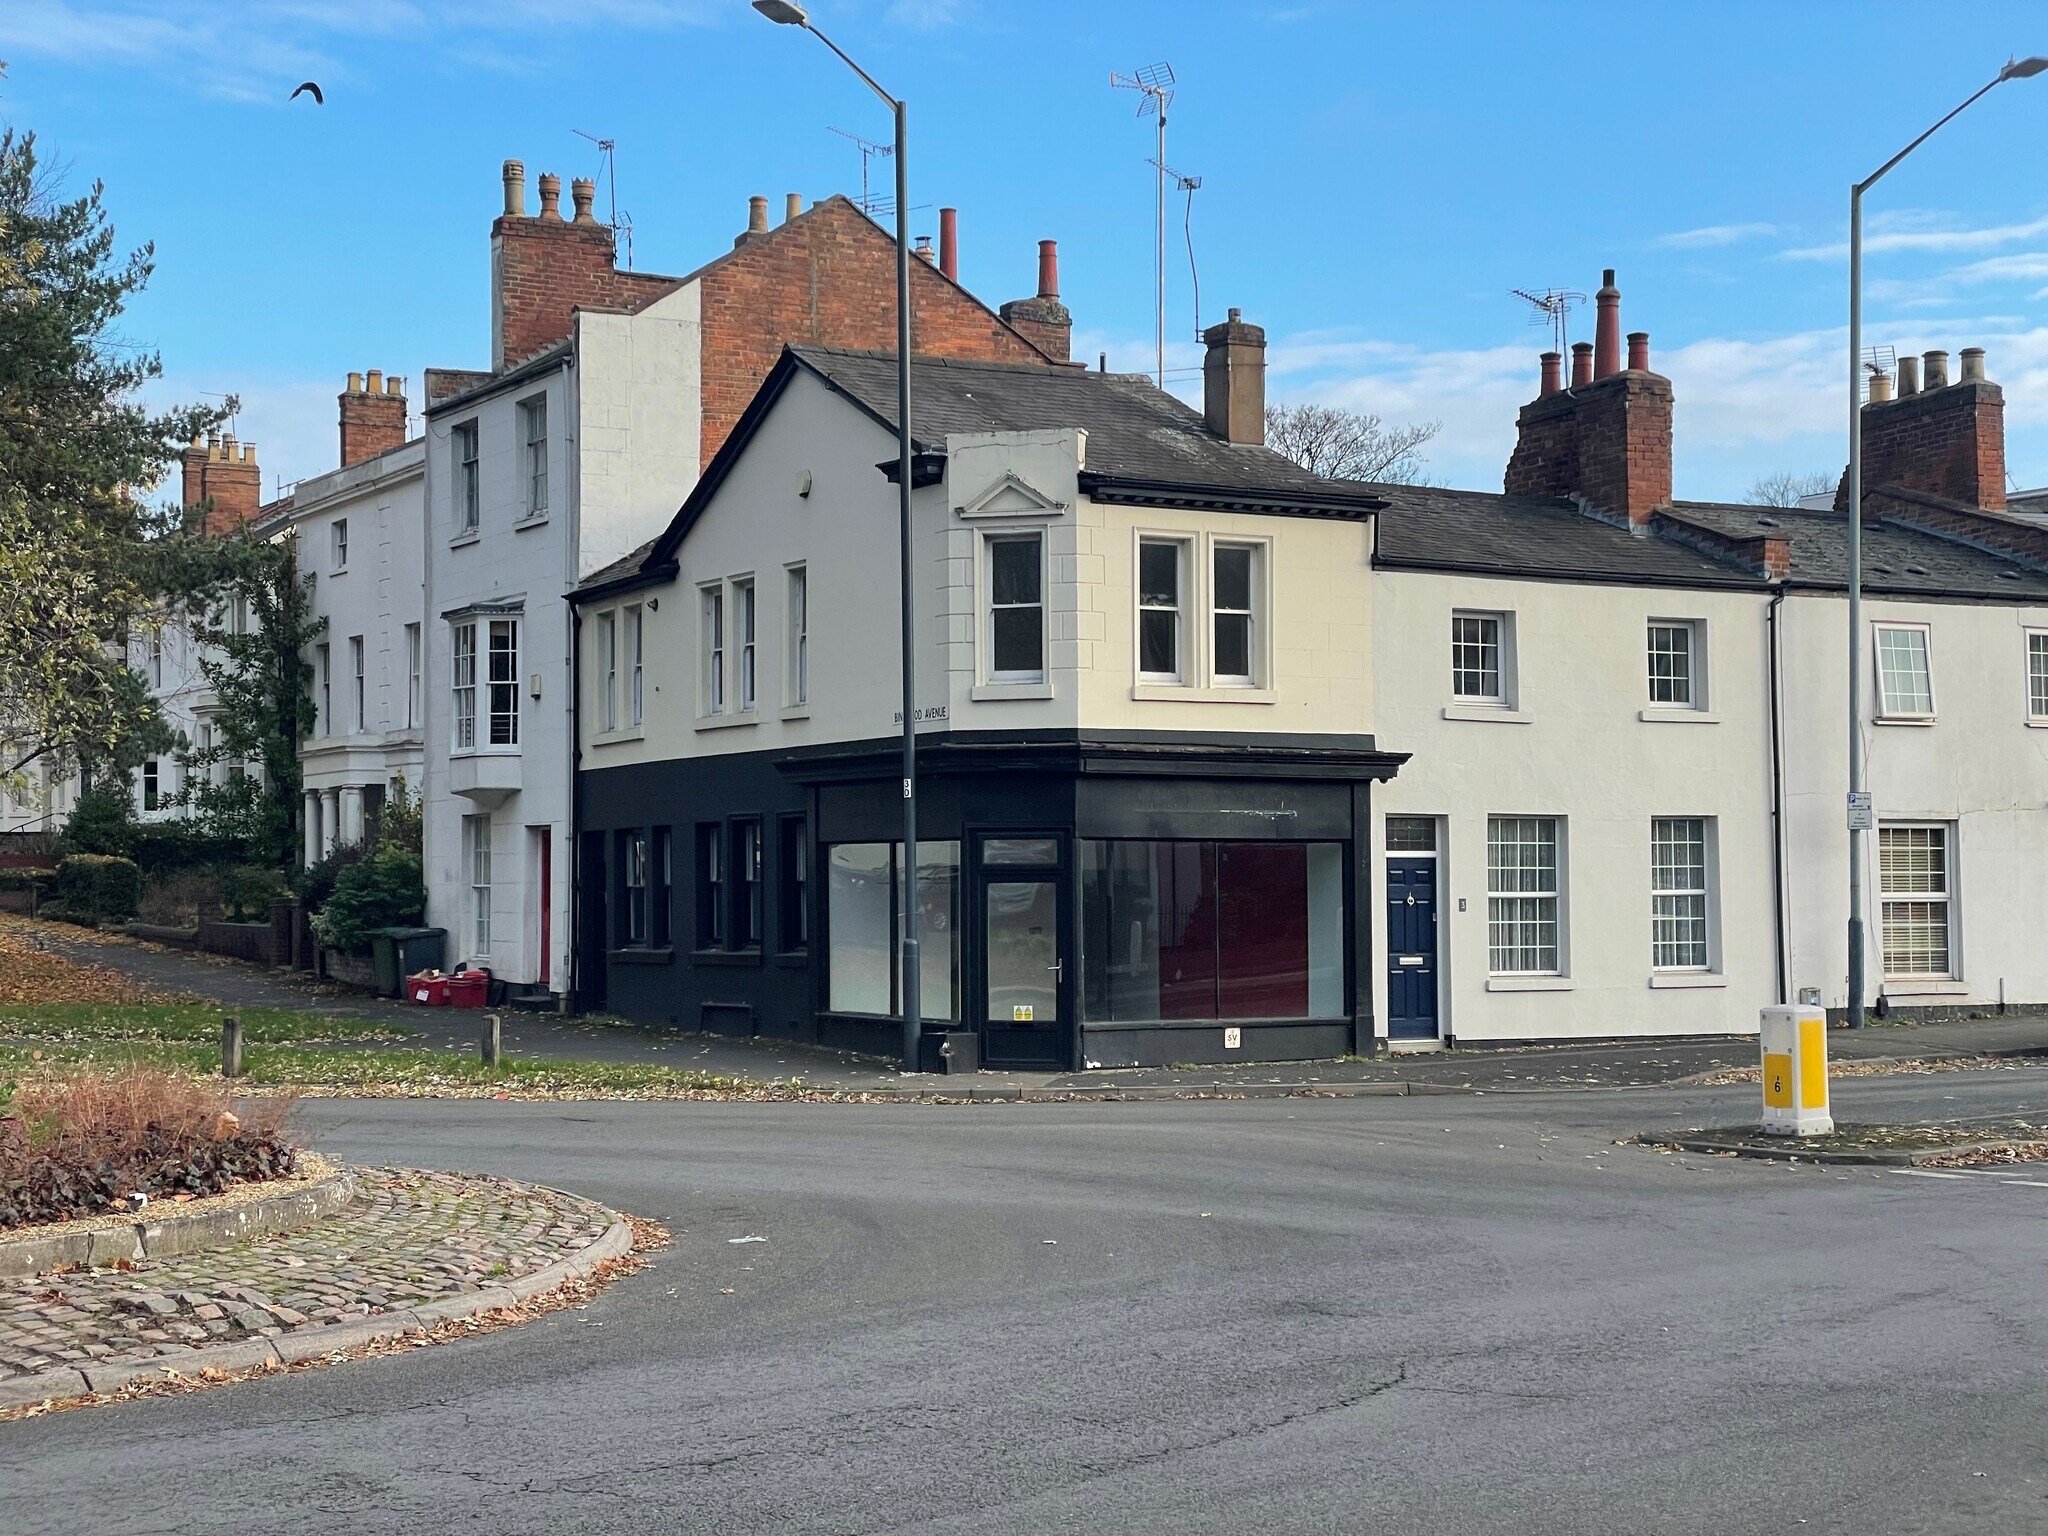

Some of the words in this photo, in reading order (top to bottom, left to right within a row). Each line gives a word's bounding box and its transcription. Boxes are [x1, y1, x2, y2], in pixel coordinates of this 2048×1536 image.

[894, 709, 923, 723] BINOD
[925, 706, 946, 719] AVENUE
[1460, 901, 1466, 909] 3
[1227, 1034, 1238, 1042] SV
[1774, 1081, 1781, 1093] 6
